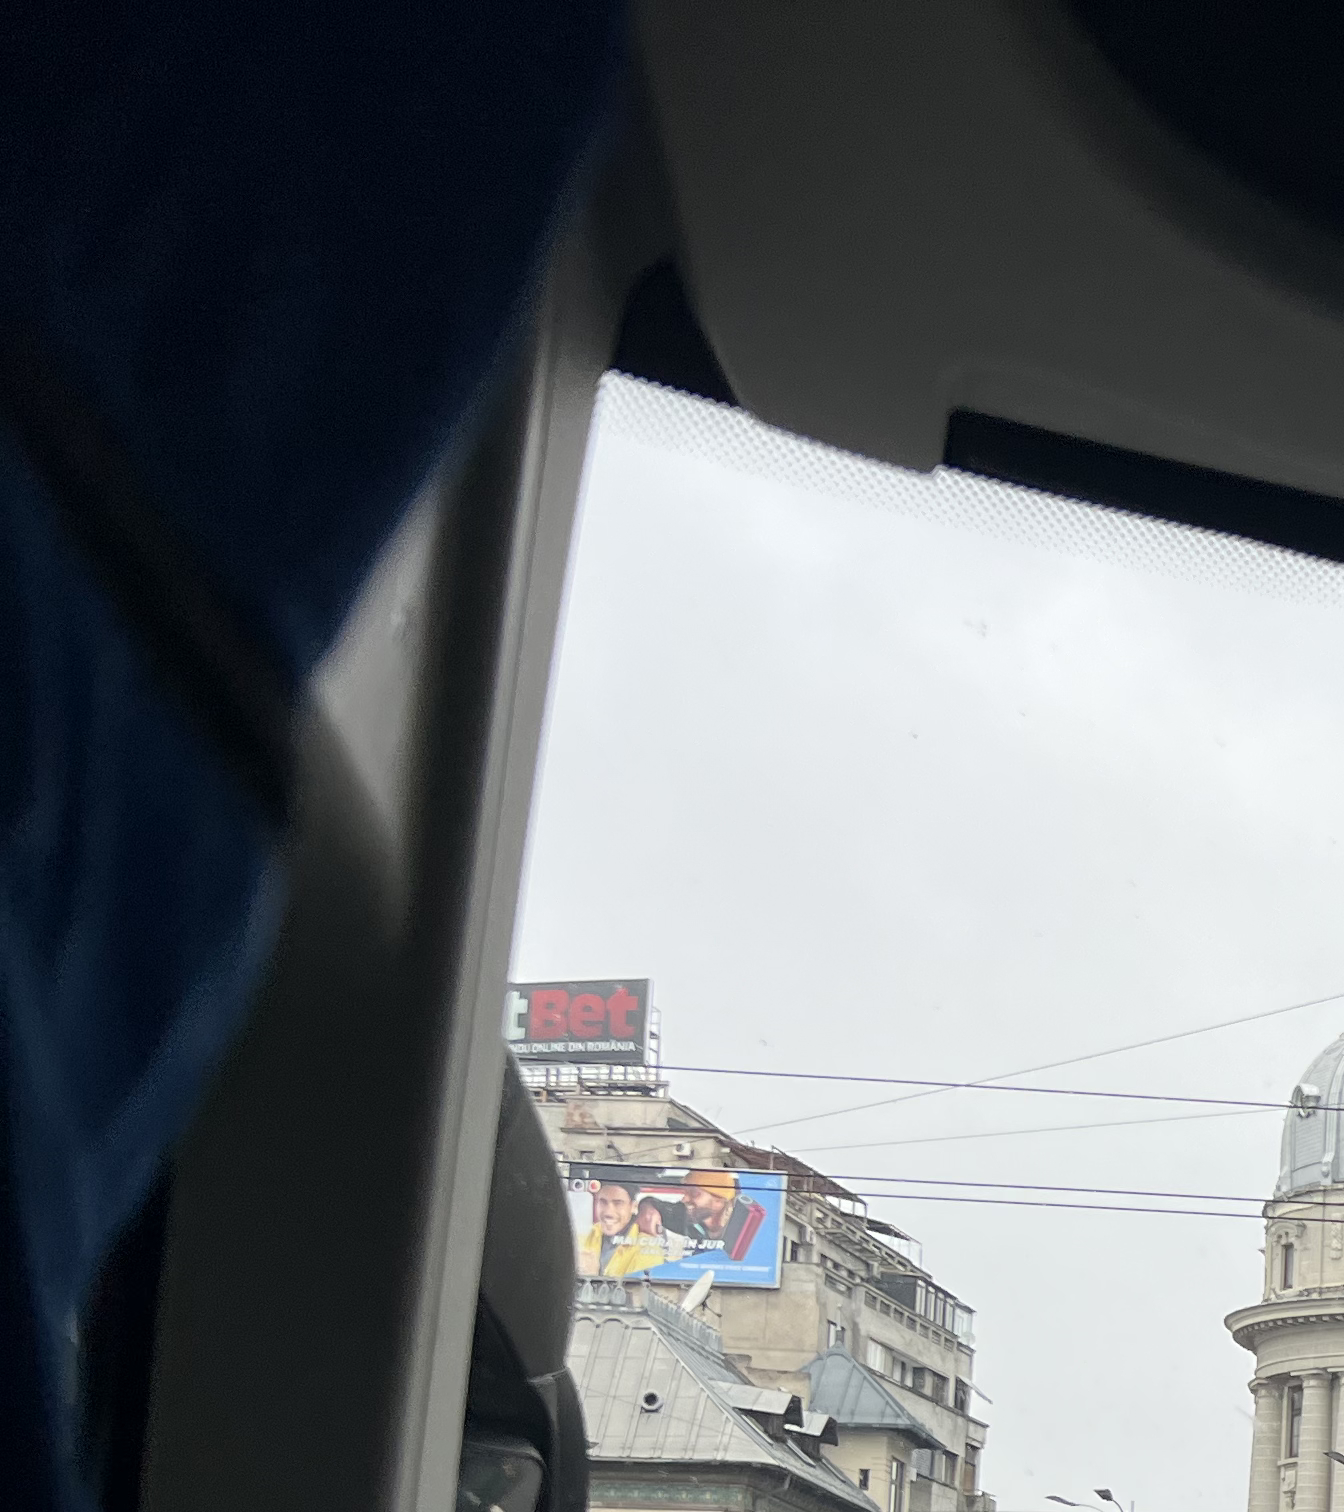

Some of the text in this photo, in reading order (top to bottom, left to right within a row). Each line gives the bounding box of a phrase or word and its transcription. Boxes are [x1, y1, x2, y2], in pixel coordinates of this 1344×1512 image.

[532, 1042, 566, 1053] ONLINE
[568, 1042, 586, 1052] DIN
[698, 1239, 725, 1250] JUR
